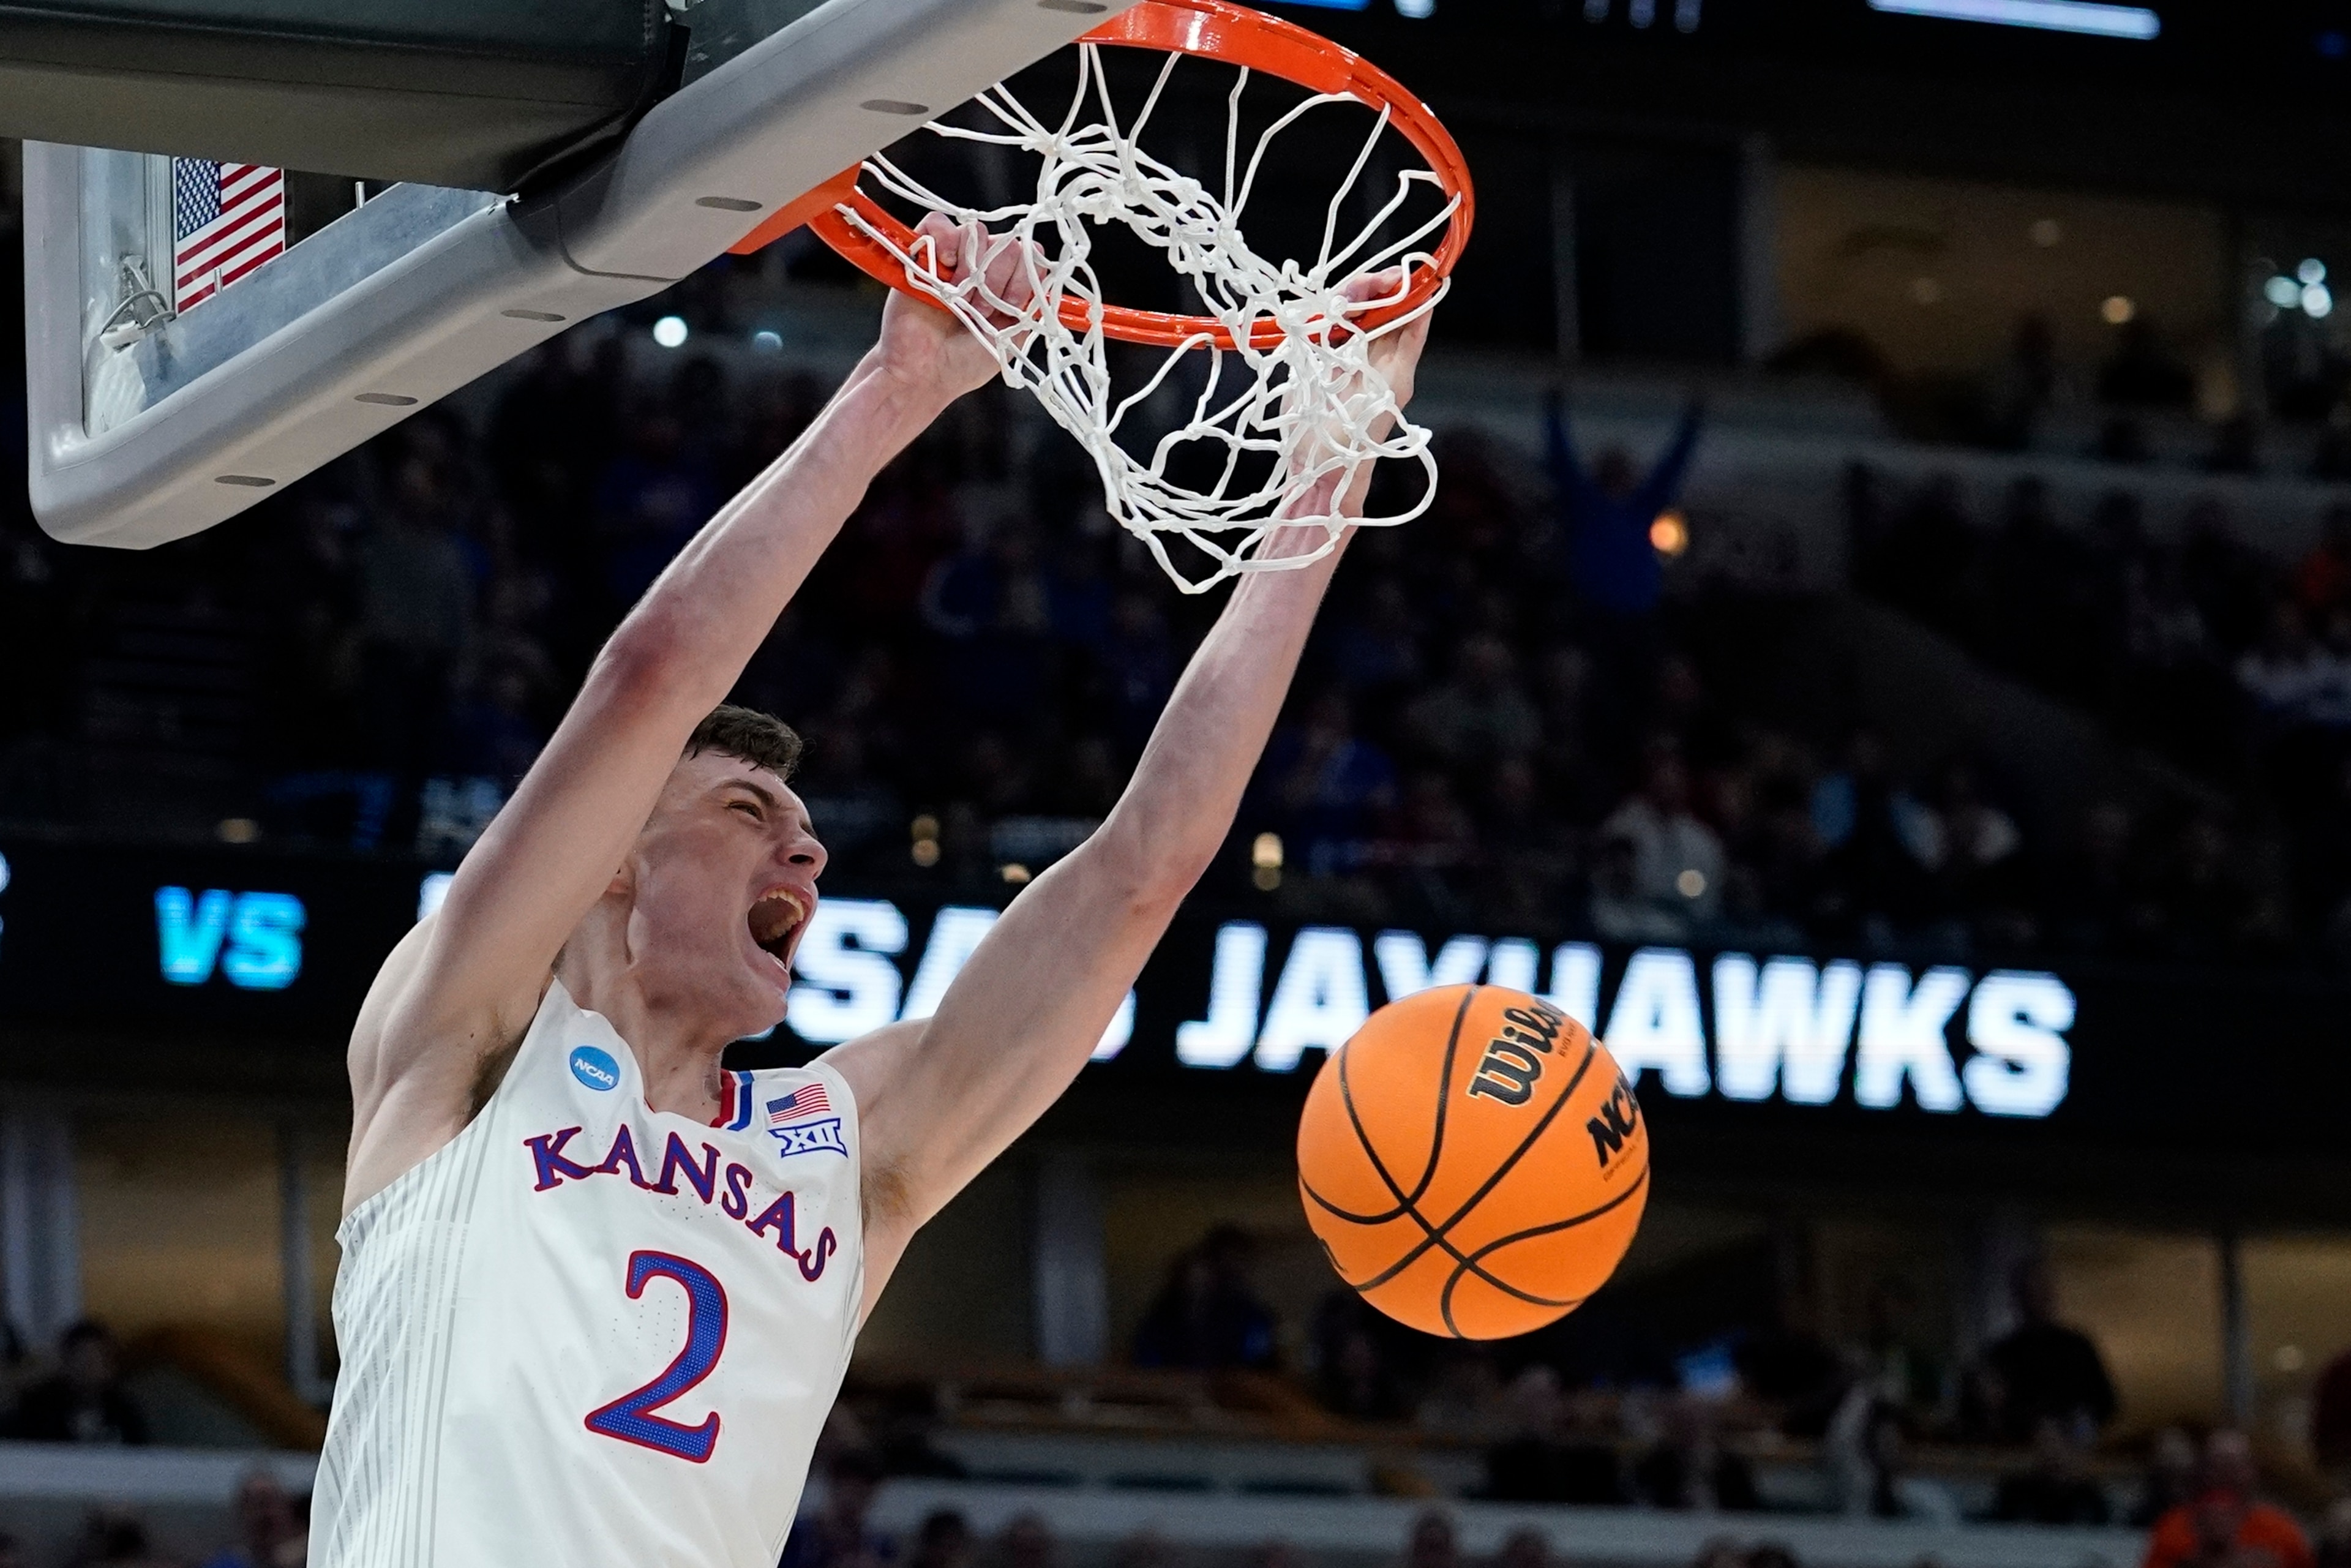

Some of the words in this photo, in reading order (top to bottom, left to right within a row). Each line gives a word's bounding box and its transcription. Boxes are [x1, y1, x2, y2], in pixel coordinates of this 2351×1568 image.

[154, 885, 307, 991] VS
[574, 1058, 615, 1086] NCAA
[1586, 1075, 1639, 1168] NC
[524, 1124, 837, 1282] KANSAS
[584, 1250, 729, 1464] 2
